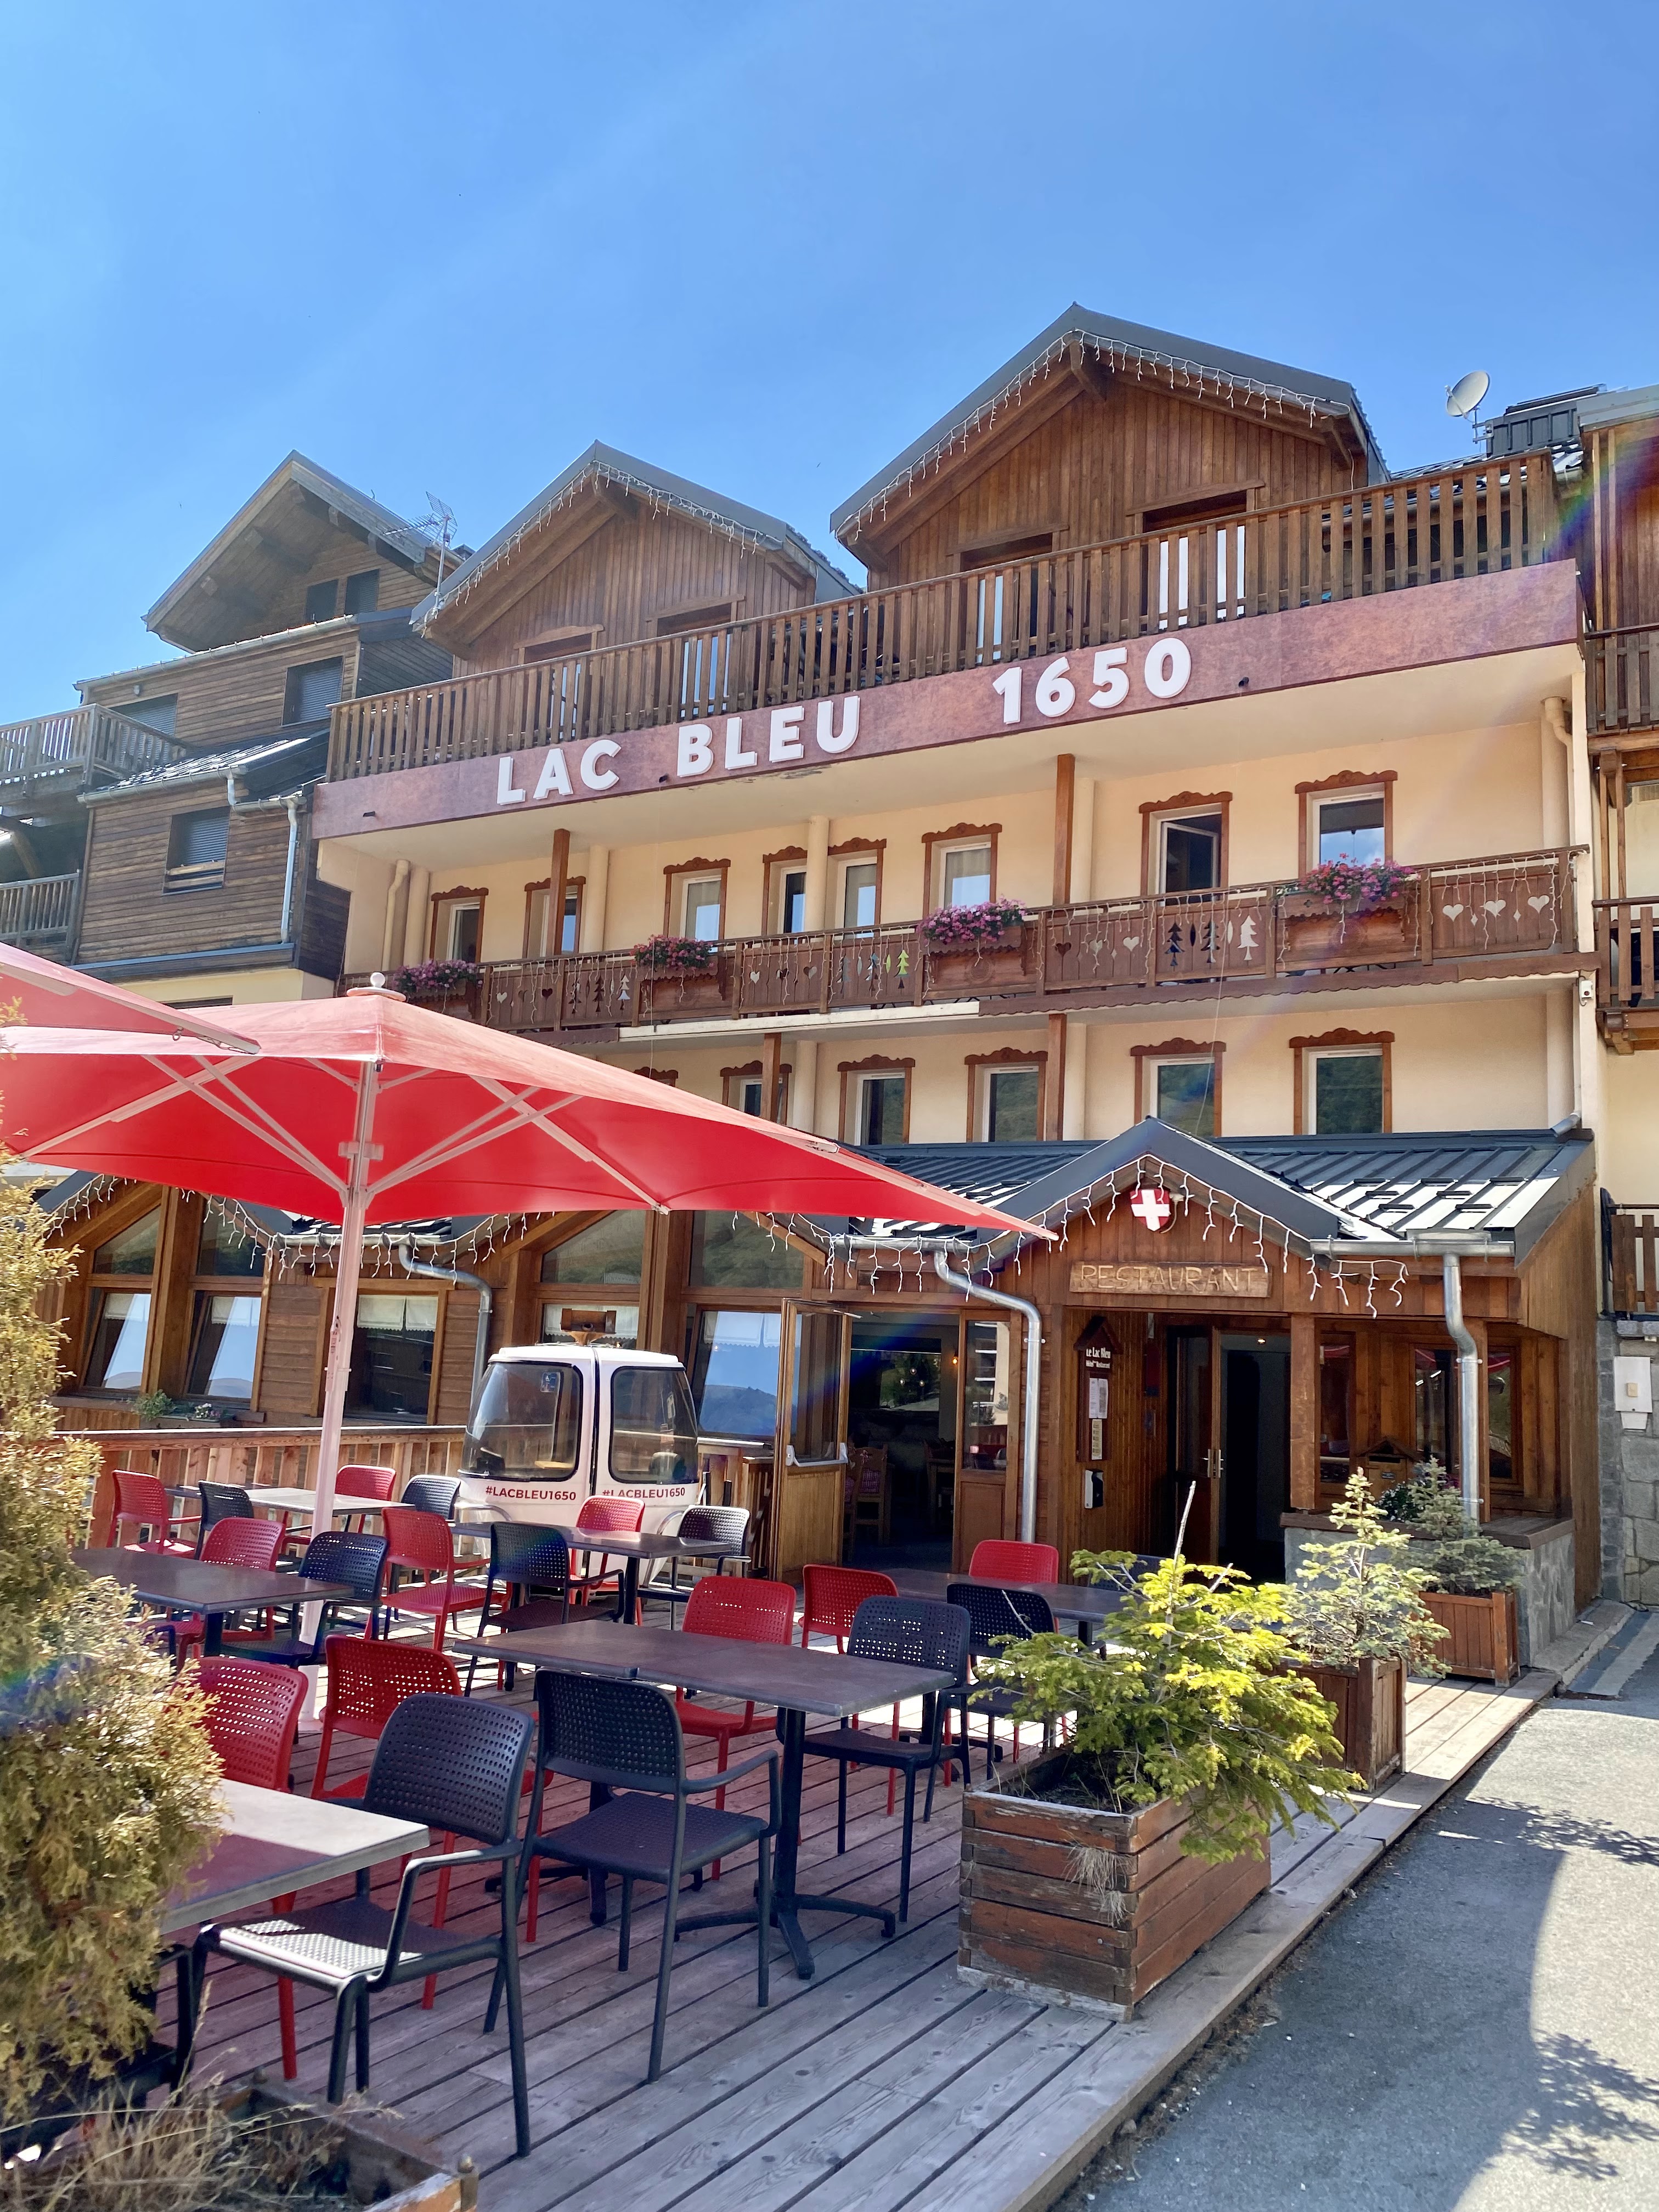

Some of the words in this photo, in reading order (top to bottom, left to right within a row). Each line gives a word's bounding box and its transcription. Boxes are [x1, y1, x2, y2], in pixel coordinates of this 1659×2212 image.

[496, 738, 622, 805] LAC
[676, 695, 861, 777] BLEU
[992, 637, 1192, 725] 1650
[1080, 1265, 1259, 1292] RESTAURANT
[485, 1485, 577, 1501] #LACBLEU1650
